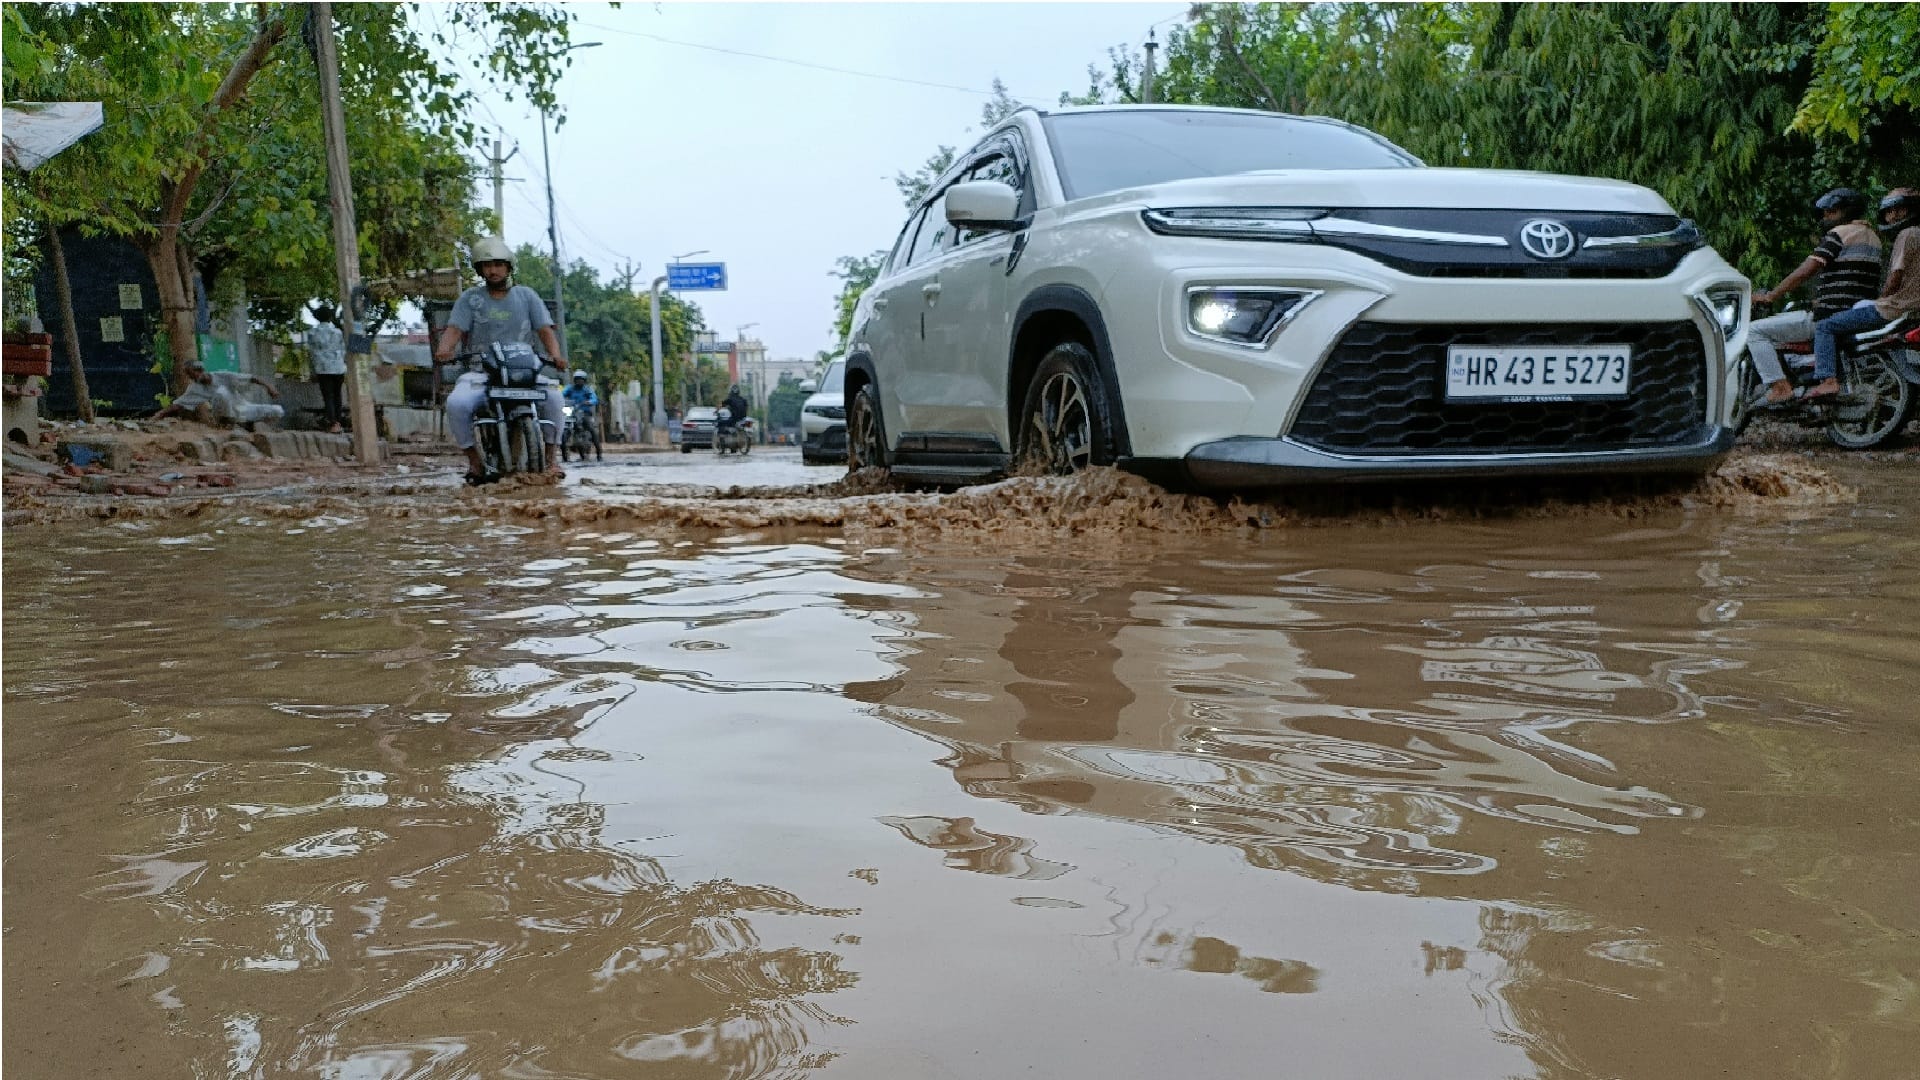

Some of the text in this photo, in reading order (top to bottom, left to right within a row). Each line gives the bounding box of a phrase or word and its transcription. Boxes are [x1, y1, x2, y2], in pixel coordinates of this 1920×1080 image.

[1451, 368, 1465, 377] IND
[1467, 356, 1625, 385] HR 43 E 5273
